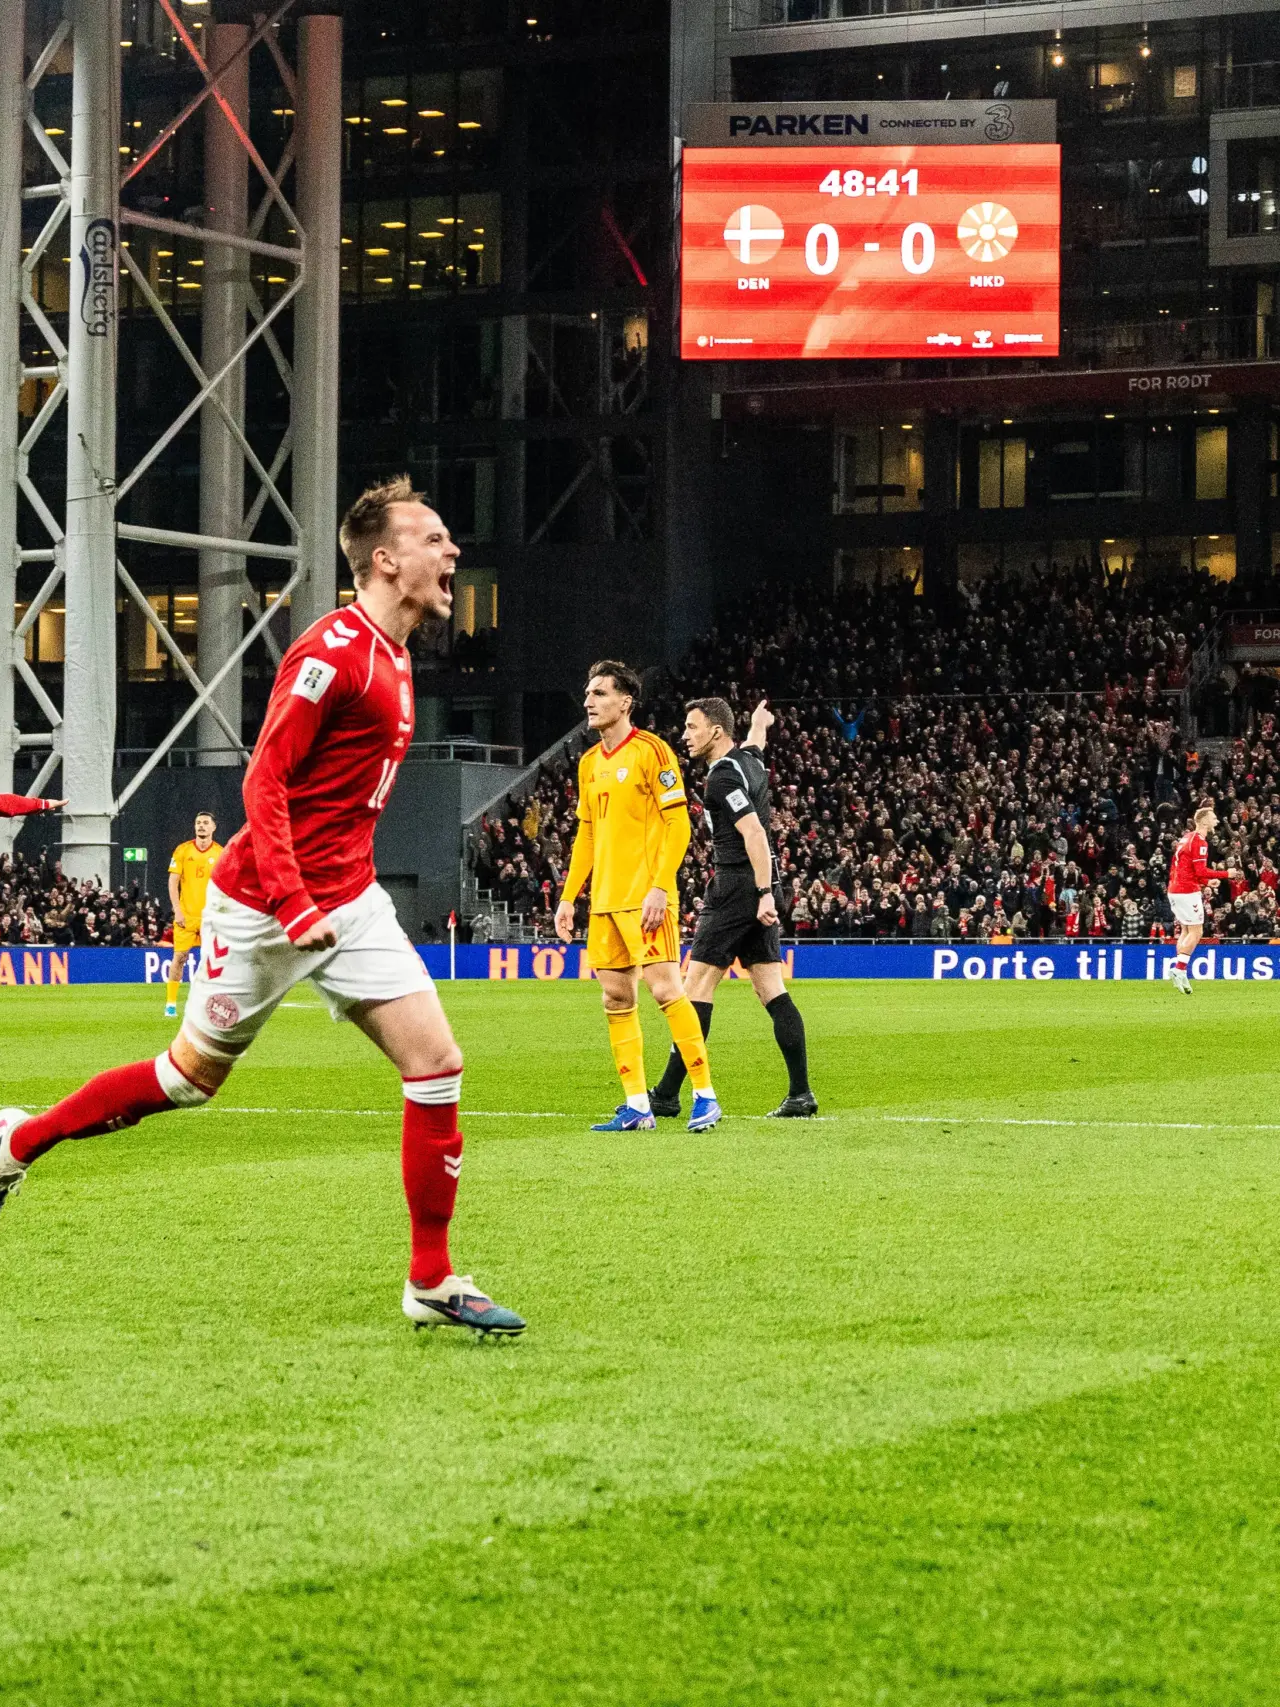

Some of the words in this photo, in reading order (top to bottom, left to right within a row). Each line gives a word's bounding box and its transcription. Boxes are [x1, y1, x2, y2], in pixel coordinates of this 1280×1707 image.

[729, 114, 869, 136] PARKEN
[879, 118, 957, 129] CONNECTED
[960, 118, 976, 128] BY
[819, 169, 919, 197] 48:41
[804, 222, 839, 275] 0
[900, 222, 935, 274] 0
[84, 217, 116, 337] Carlsberg
[737, 277, 770, 290] DEN
[969, 275, 1005, 287] MKD
[1128, 377, 1162, 391] FOR
[1166, 374, 1212, 389] RØDT
[1254, 628, 1280, 640] FOR
[598, 792, 609, 819] 17
[195, 866, 205, 879] 15
[933, 949, 1055, 980] Porte
[1077, 949, 1123, 980] til
[1146, 949, 1280, 980] indus
